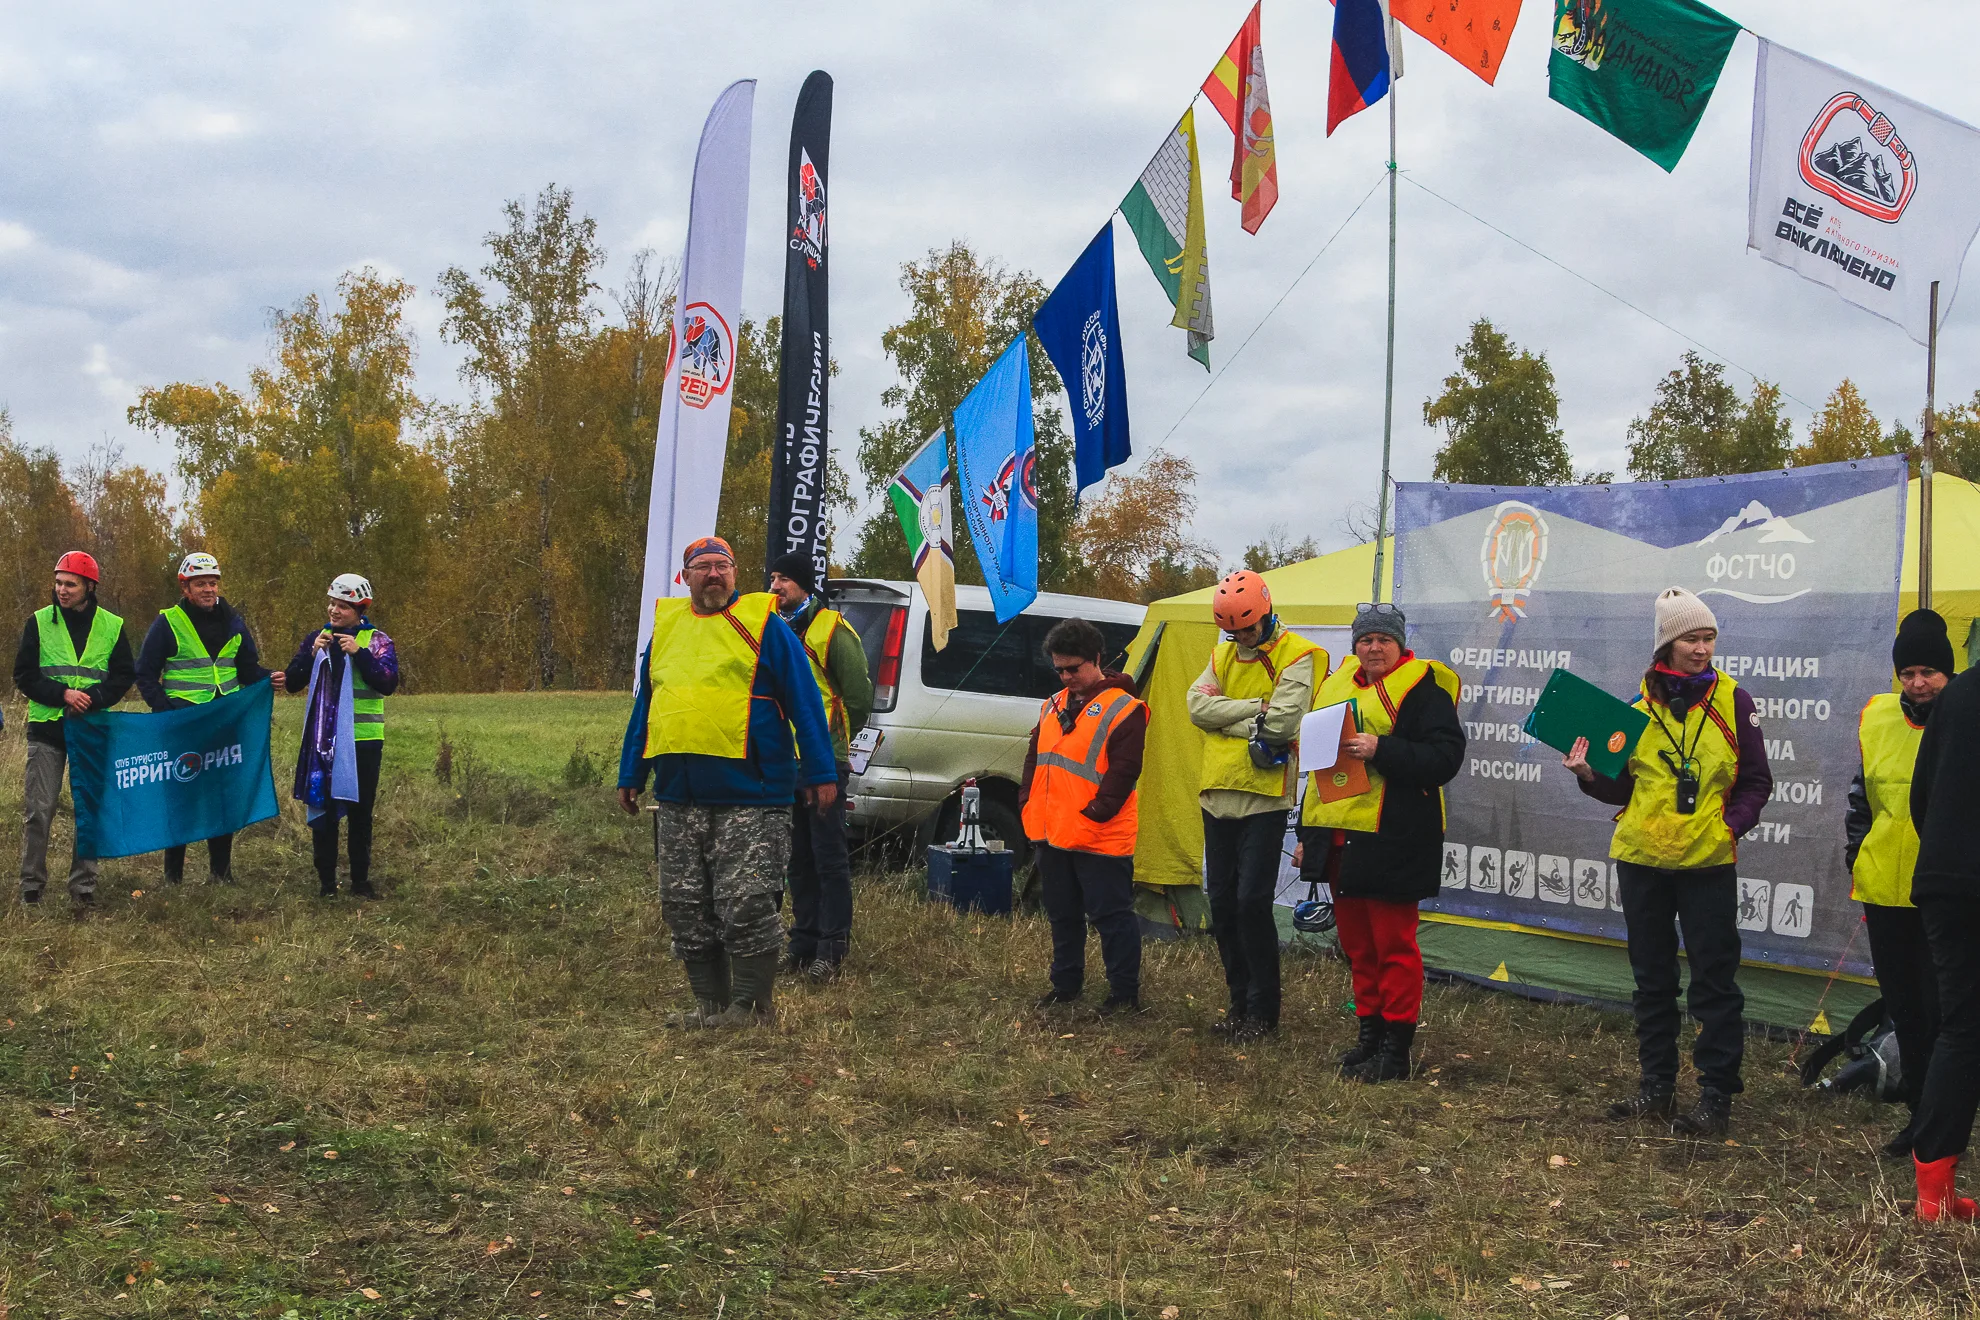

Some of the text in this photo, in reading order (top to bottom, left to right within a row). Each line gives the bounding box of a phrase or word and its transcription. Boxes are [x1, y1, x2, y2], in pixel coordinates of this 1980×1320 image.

[1782, 197, 1823, 229] ВСЁ
[680, 376, 708, 397] RED
[1706, 552, 1796, 582] ФСТЧО
[1450, 648, 1571, 671] ФЕДЕРАЦИЯ
[1461, 684, 1540, 706] ОРТИВН
[115, 751, 168, 769] КЛУБ ТУРИСТОВ
[1470, 759, 1541, 783] РОССИИ
